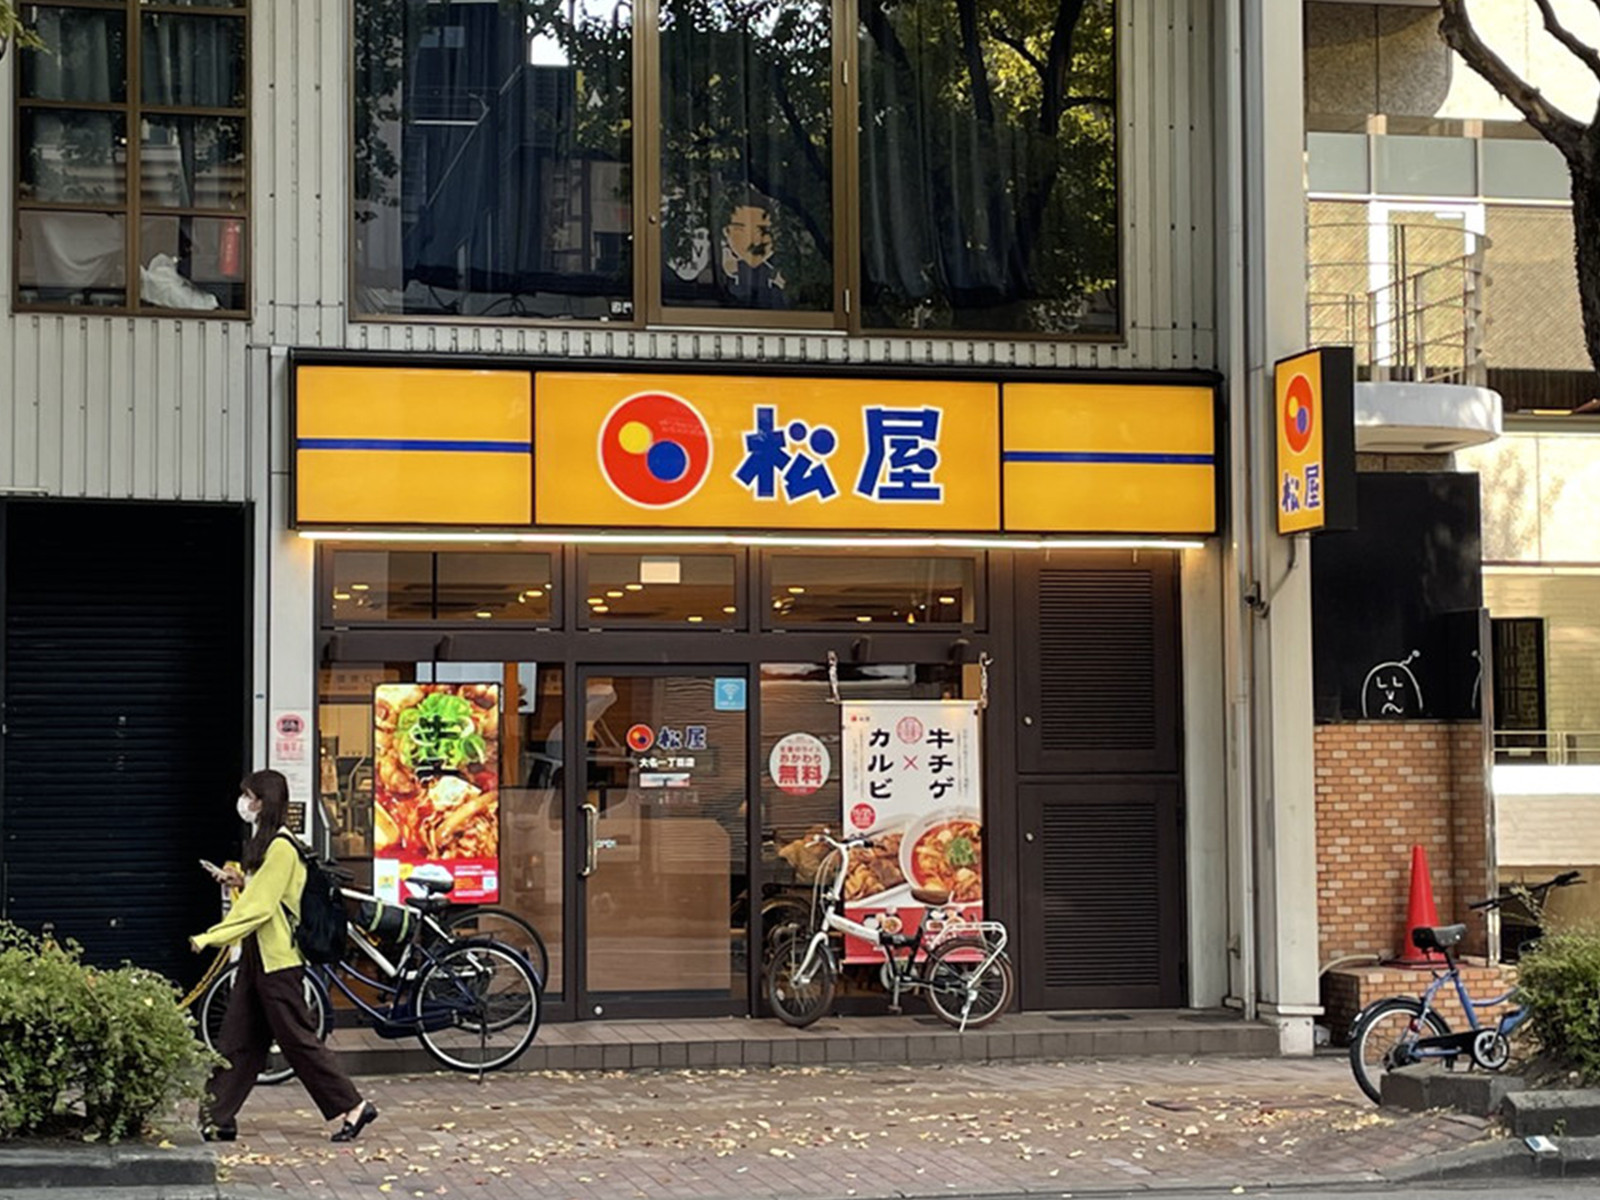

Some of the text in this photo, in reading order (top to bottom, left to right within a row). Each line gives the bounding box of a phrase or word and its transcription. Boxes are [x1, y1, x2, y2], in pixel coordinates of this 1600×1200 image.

[733, 404, 943, 503] 松屋
[1281, 464, 1321, 513] 松屋
[657, 726, 707, 750] 松屋
[780, 754, 822, 763] おかわり
[779, 765, 822, 784] 無料
[868, 728, 894, 799] カルビ
[926, 728, 955, 799] 牛チゲ
